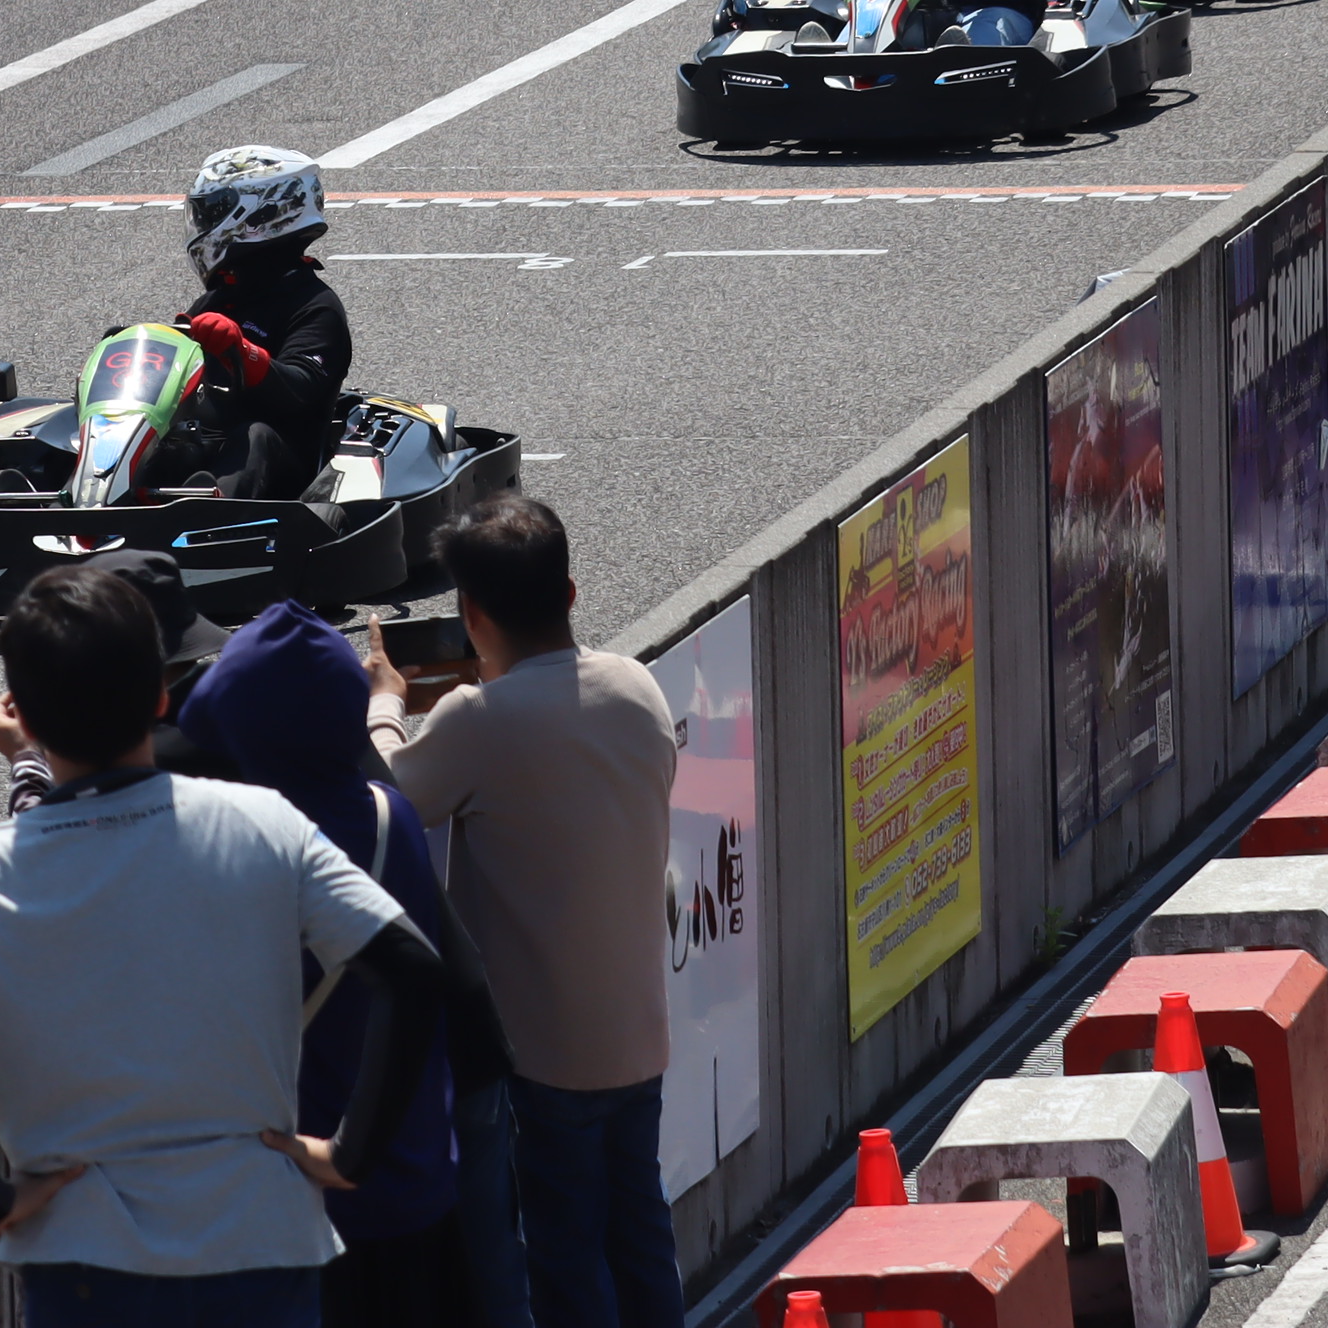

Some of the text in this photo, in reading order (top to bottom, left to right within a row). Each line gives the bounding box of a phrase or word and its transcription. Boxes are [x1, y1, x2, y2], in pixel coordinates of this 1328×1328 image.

[1231, 301, 1266, 399] TEAM
[1267, 239, 1322, 370] FARINA
[917, 473, 947, 531] SHOP
[869, 592, 919, 672] Factory
[921, 550, 966, 640] Racing
[912, 825, 971, 902] 052-739-6133
